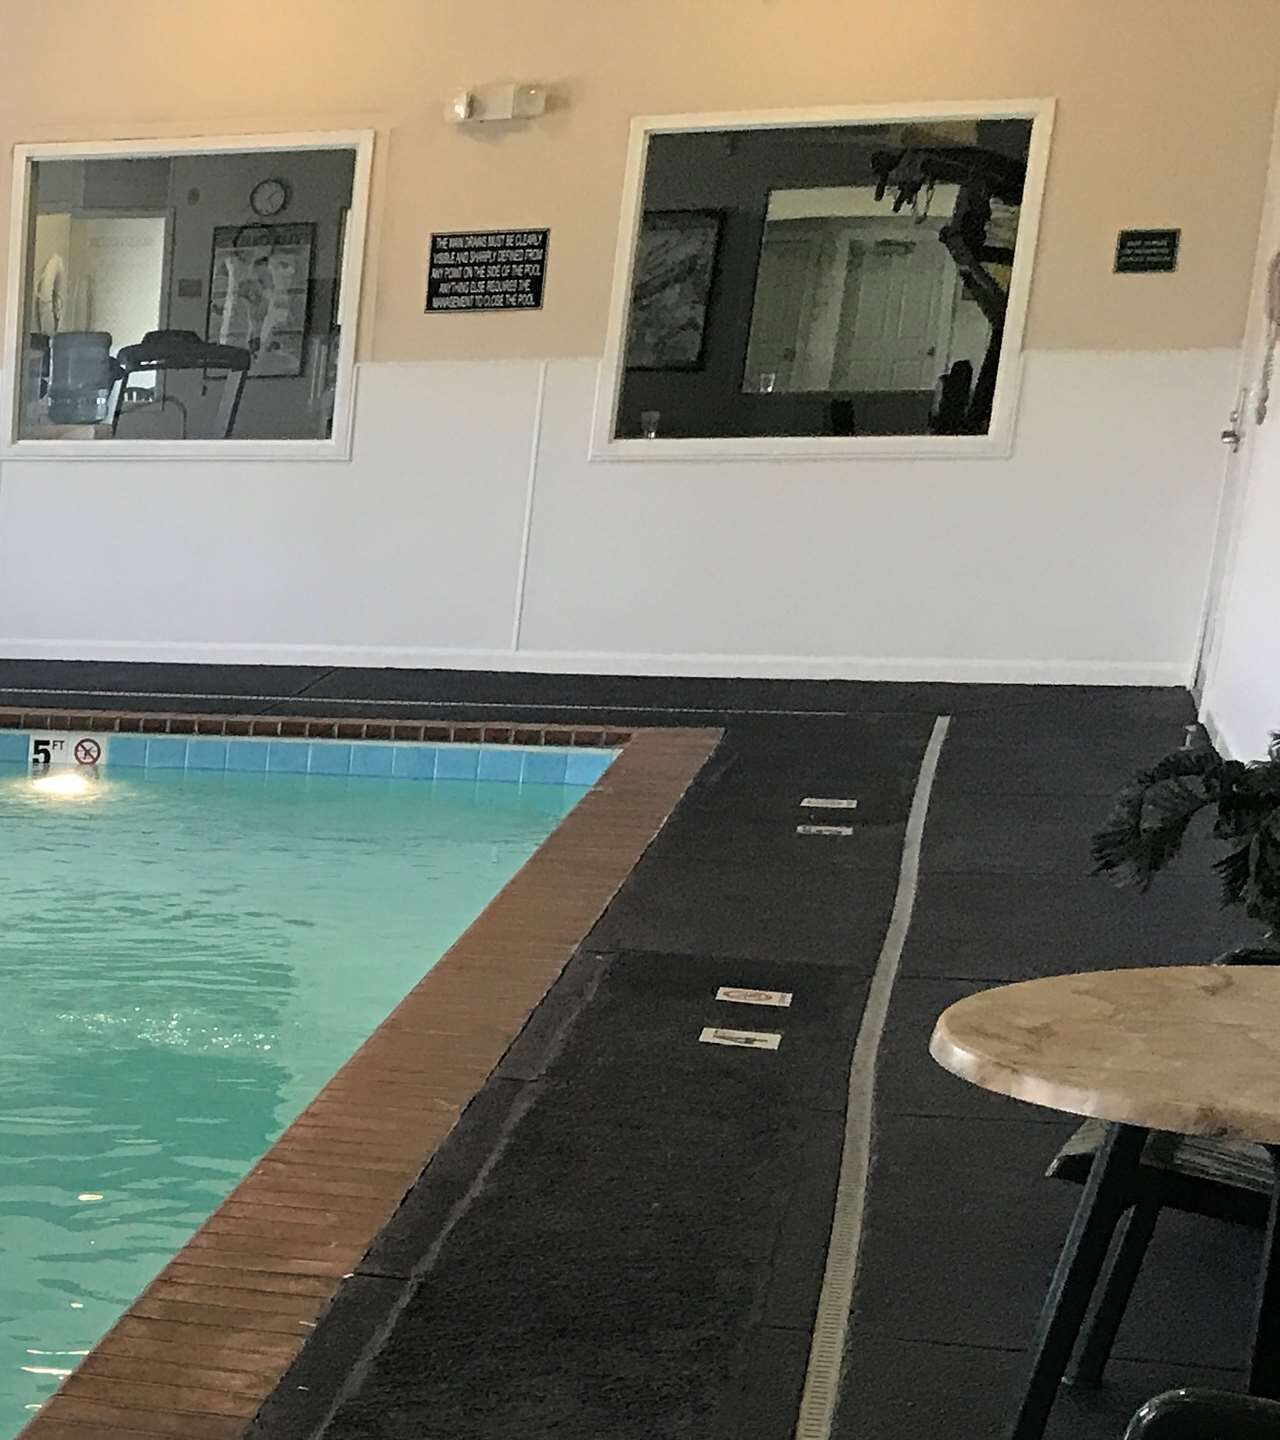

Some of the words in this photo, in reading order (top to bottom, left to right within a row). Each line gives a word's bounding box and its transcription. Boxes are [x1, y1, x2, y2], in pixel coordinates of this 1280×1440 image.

[436, 237, 448, 249] THE
[488, 234, 505, 247] MUST
[506, 233, 515, 247] BE
[515, 233, 543, 246] CLEARLY
[456, 251, 469, 264] AND
[469, 250, 497, 263] SHARPLY
[497, 249, 524, 262] DEFINED
[524, 248, 544, 260] FROM
[431, 267, 443, 279] ANY
[444, 266, 463, 279] POINT
[463, 266, 473, 278] ON
[474, 265, 486, 278] THE
[486, 264, 501, 277] SIDE
[501, 264, 511, 277] OF
[511, 264, 524, 276] THE
[439, 281, 469, 294] ANYTHING
[470, 280, 485, 293] ELSE
[486, 279, 518, 292] REQUIRES
[518, 279, 531, 291] THE
[432, 295, 474, 308] MANAGEMENT
[475, 295, 483, 307] TO
[484, 294, 504, 307] CLOSE
[505, 293, 517, 306] THE
[32, 740, 51, 764] 5
[52, 740, 65, 750] FT
